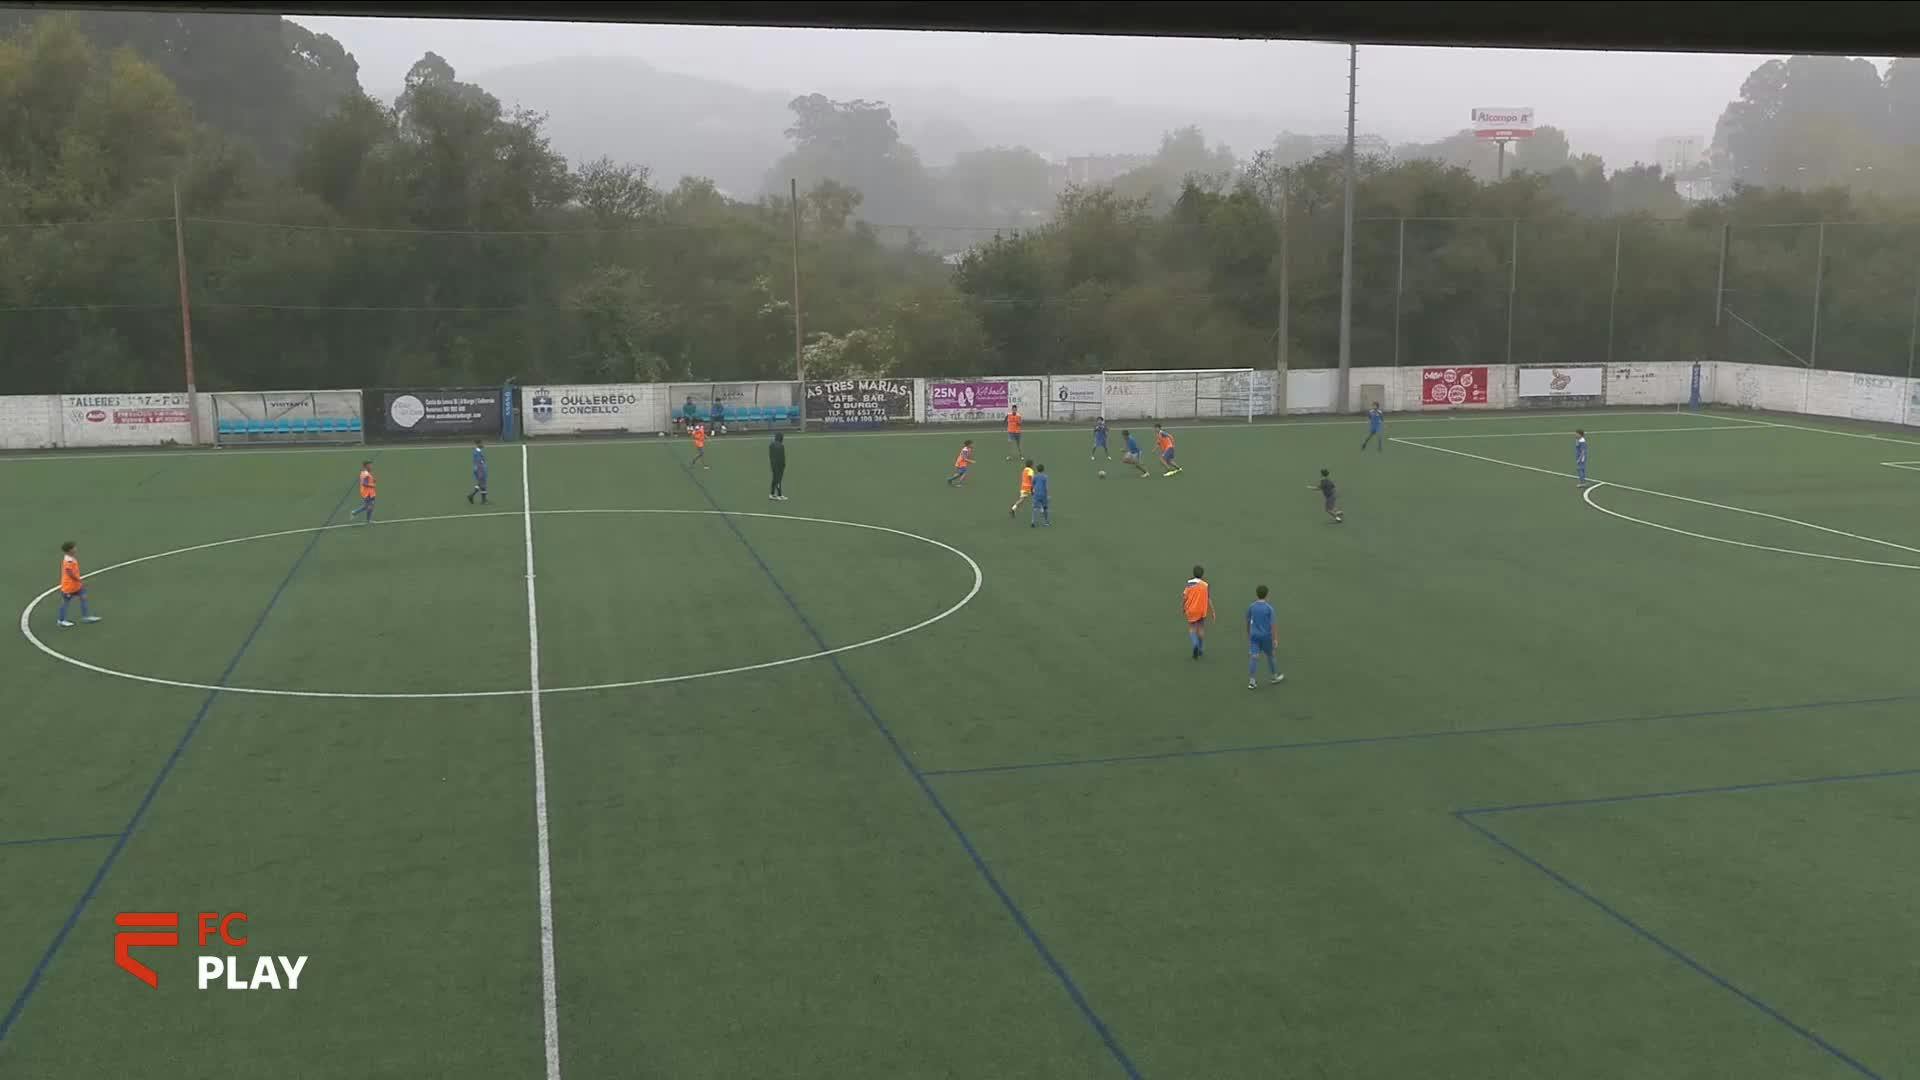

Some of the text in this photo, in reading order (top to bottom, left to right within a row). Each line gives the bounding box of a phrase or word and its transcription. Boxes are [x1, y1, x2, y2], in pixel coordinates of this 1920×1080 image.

[825, 380, 854, 393] TRES
[933, 387, 957, 398] 25N
[862, 394, 885, 402] BAR
[560, 405, 620, 415] CONCELLO
